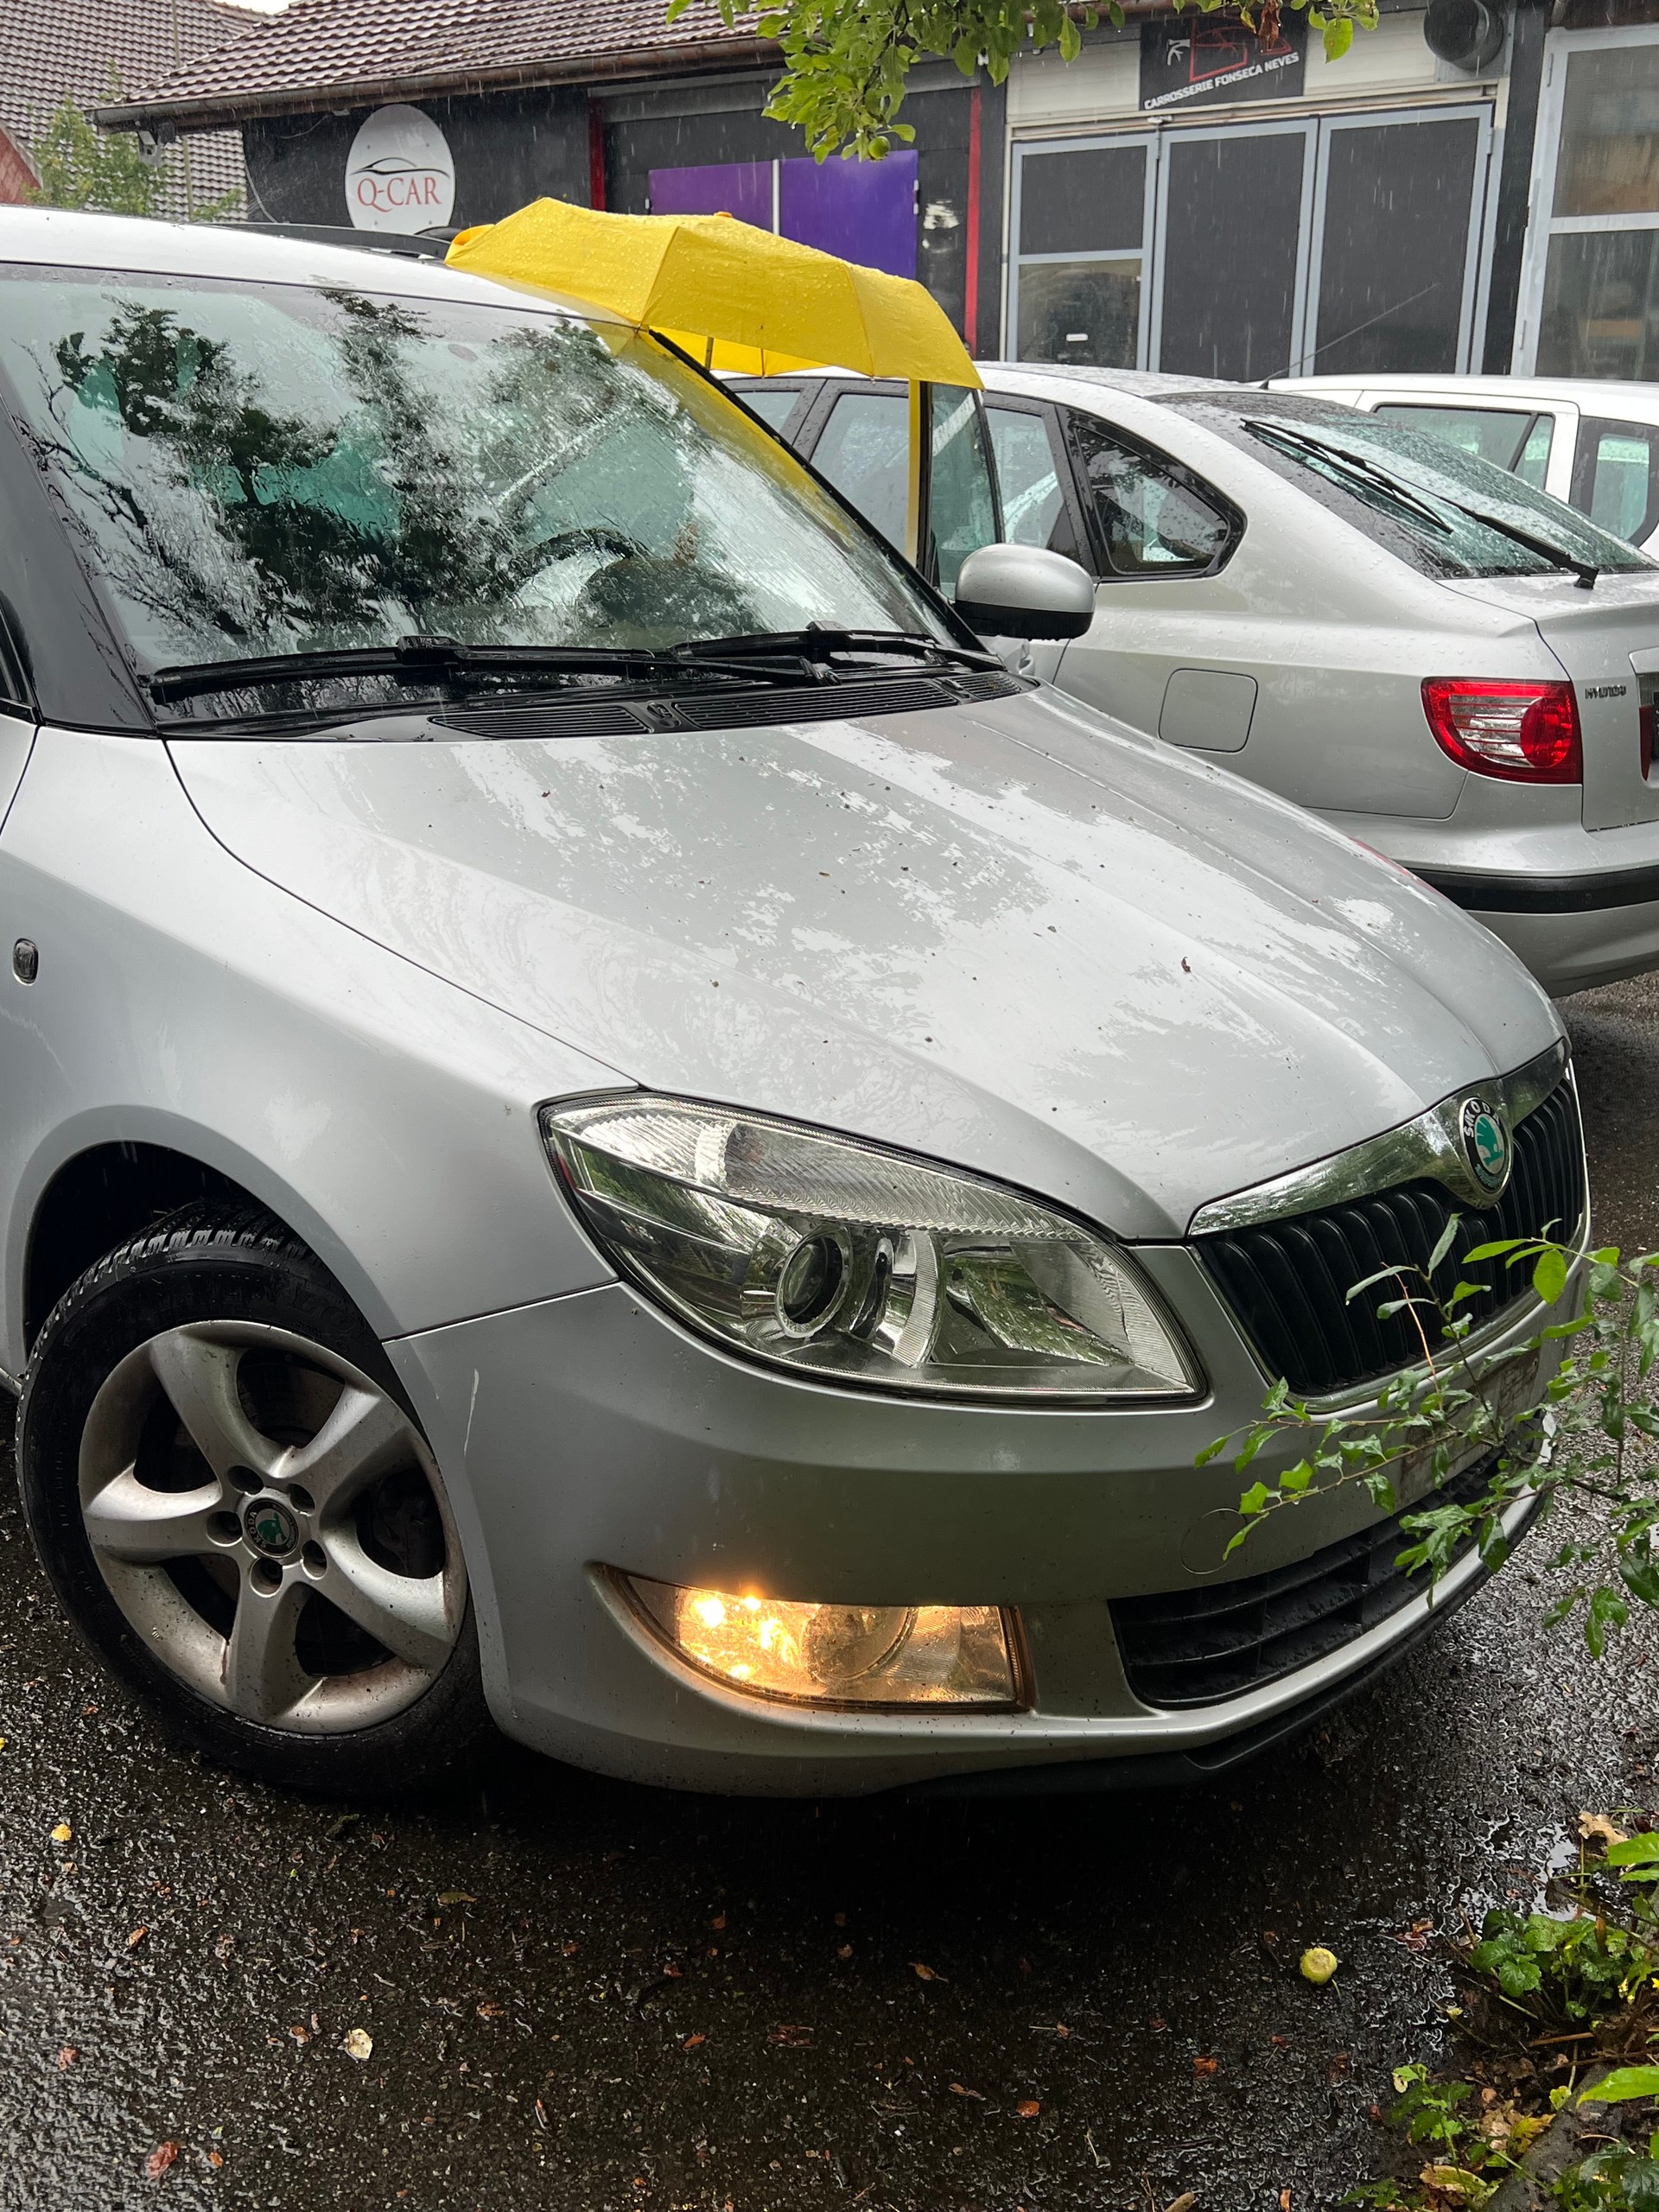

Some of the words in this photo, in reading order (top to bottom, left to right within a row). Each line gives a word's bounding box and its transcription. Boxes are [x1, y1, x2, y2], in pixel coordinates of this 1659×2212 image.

[1144, 79, 1214, 110] CARROSSERIE
[1215, 64, 1264, 87] FONSECA
[1264, 52, 1300, 72] NEVES
[357, 176, 442, 213] Q-CAR
